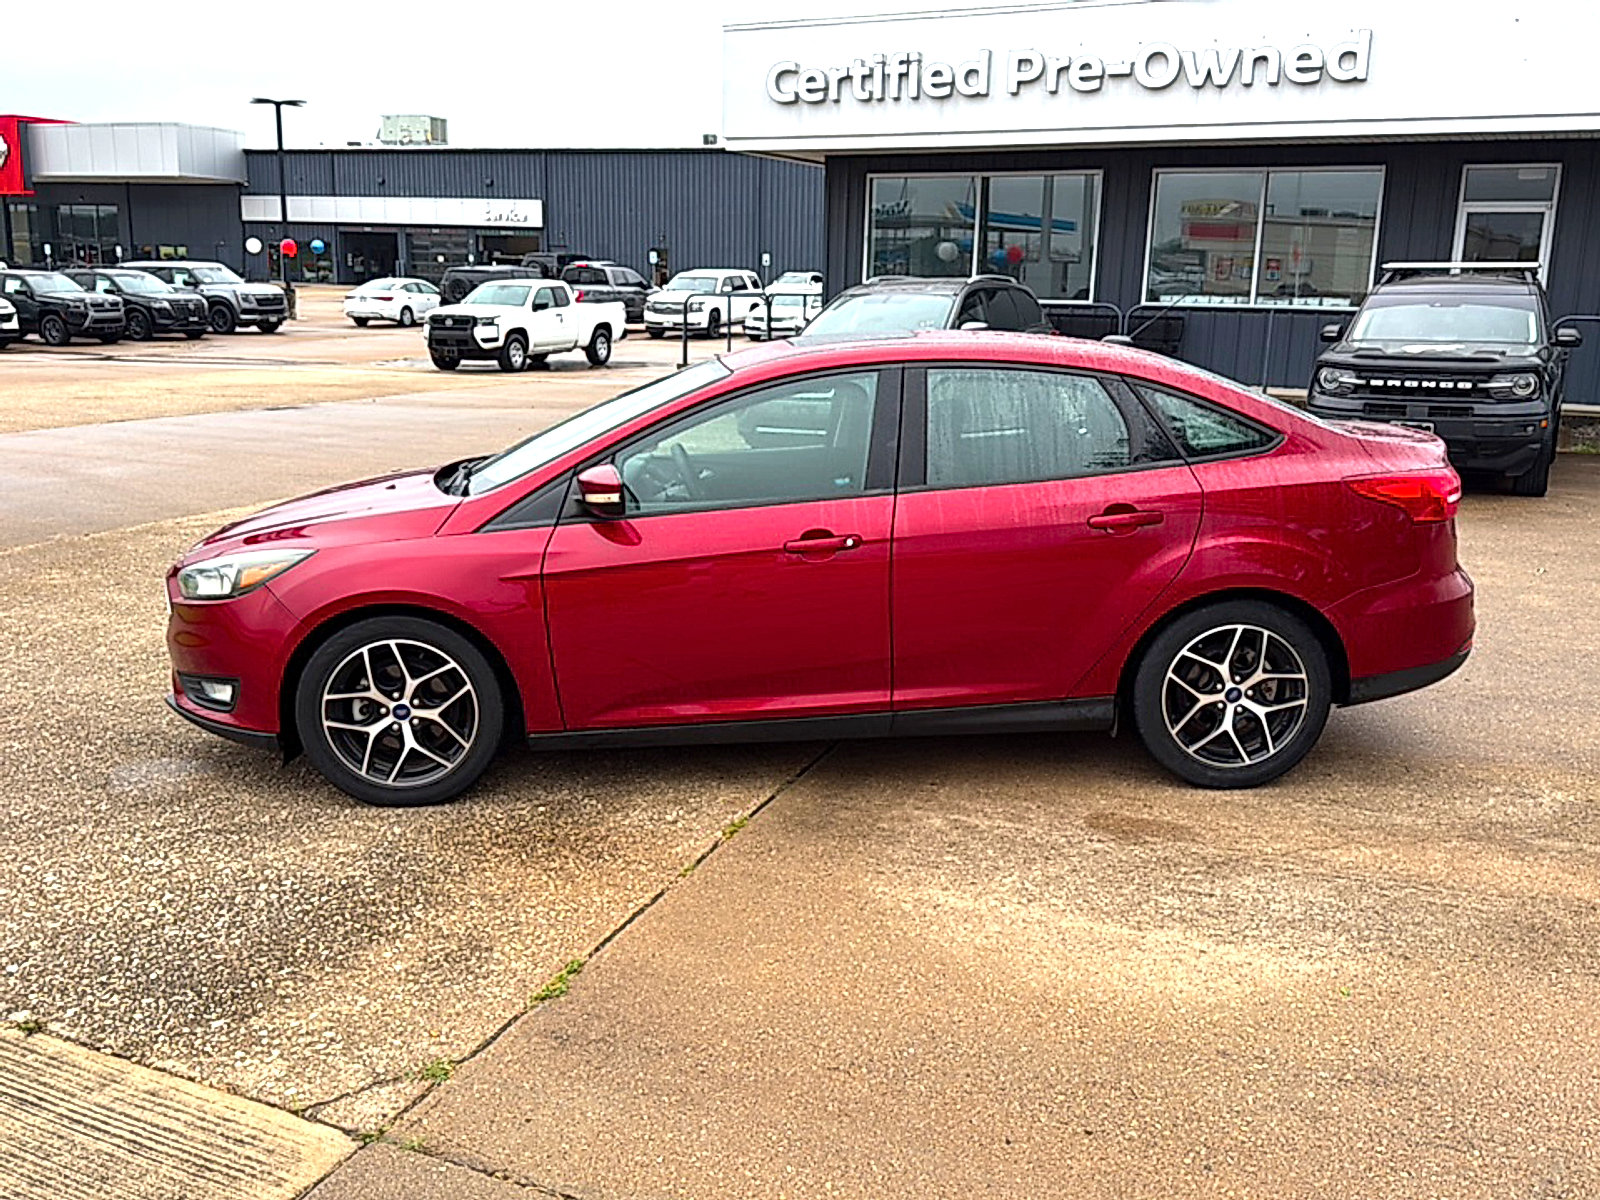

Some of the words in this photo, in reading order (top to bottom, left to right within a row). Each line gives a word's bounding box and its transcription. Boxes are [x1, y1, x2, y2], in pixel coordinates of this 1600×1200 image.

[766, 50, 991, 104] Certified
[1006, 29, 1372, 96] Pre-Owned
[1369, 379, 1473, 390] BRONCO
